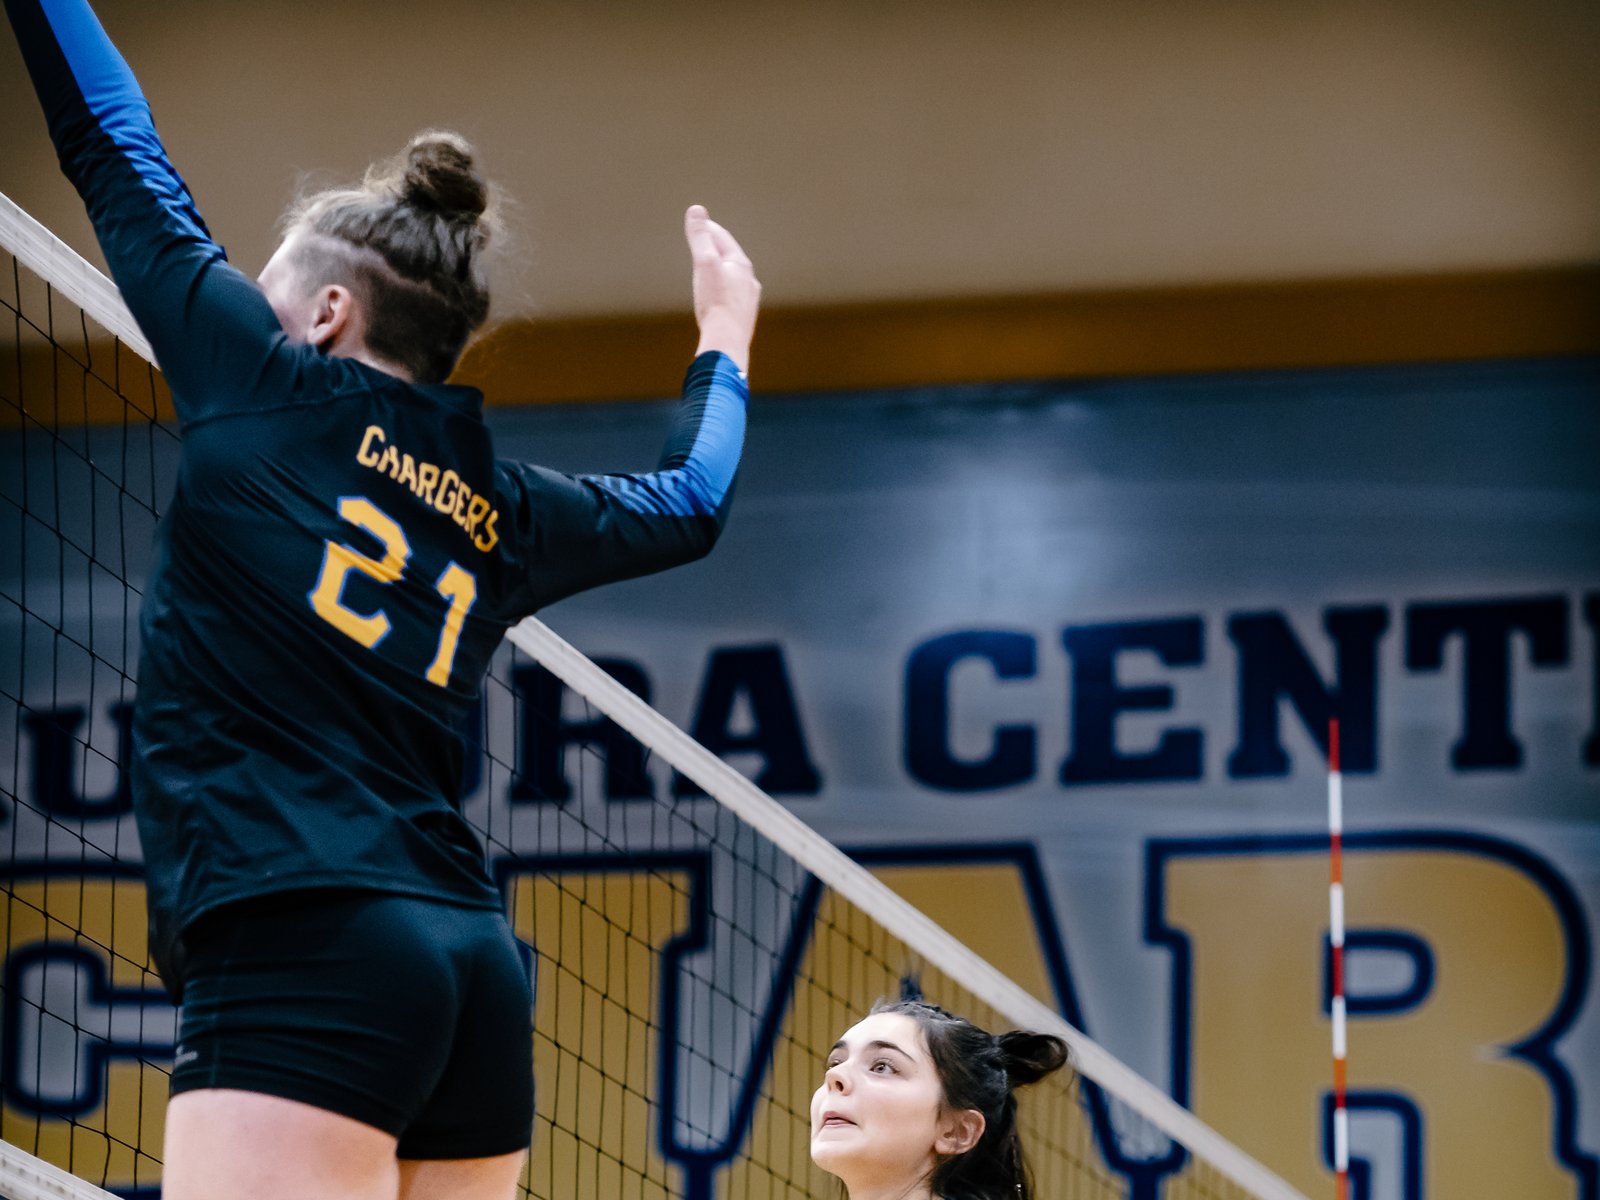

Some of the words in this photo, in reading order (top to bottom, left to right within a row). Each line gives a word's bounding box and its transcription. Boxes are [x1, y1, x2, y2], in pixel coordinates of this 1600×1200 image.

[356, 425, 499, 552] CHARGERS
[307, 496, 477, 687] 21
[901, 592, 1600, 793] CENT
